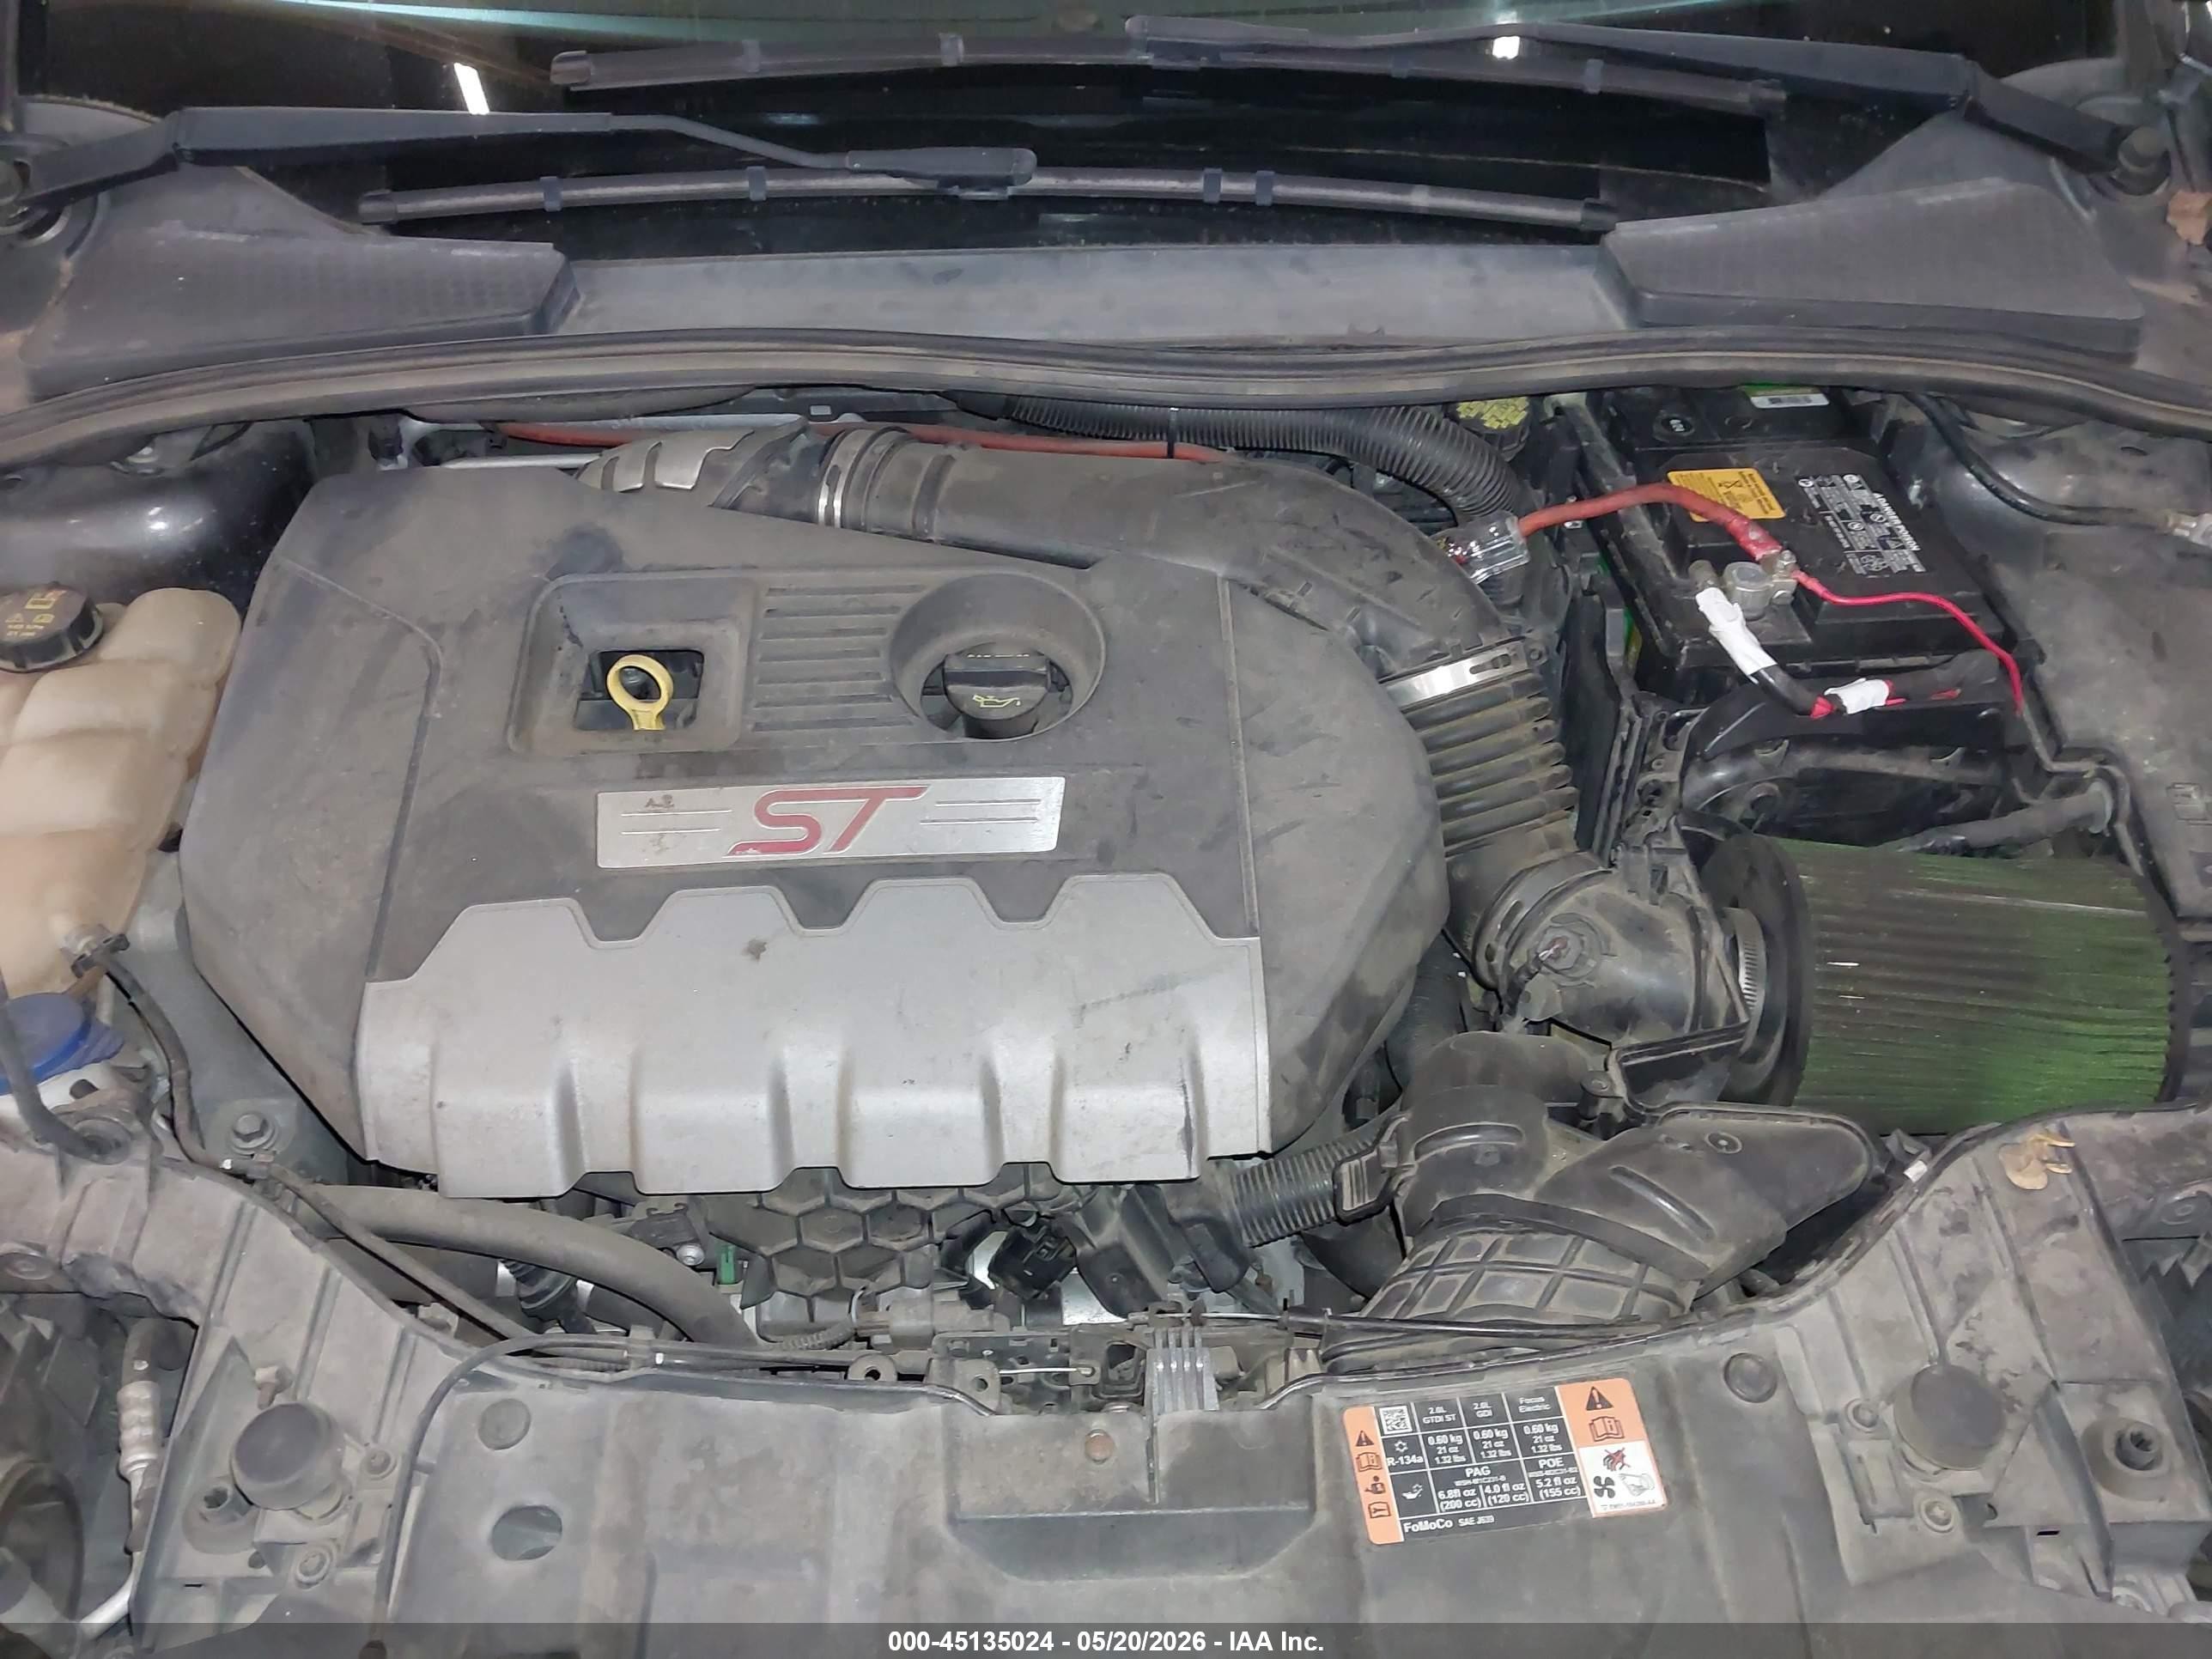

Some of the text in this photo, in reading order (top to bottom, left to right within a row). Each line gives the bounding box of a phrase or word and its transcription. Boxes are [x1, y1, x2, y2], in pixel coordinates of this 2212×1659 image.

[725, 784, 930, 858] ST
[1445, 1413, 1457, 1423] ST
[1473, 1428, 1509, 1441] 0.60 kg
[1523, 1423, 1559, 1435] 0.60 kg
[1427, 1433, 1463, 1446] 0.60 kg
[1387, 1455, 1424, 1467] R-134a
[1539, 1457, 1565, 1468] POE
[1465, 1466, 1491, 1478] PAG
[1535, 1479, 1553, 1488] 5.2
[1563, 1476, 1577, 1485] oz
[1485, 1485, 1500, 1494] 4.0
[1512, 1483, 1526, 1492] oz
[1539, 1486, 1581, 1500] (155 cc)
[1440, 1498, 1482, 1512] (200 cc)
[1487, 1492, 1529, 1507] (120 cc)
[1402, 1518, 1454, 1533] FoMoCo
[1458, 1516, 1476, 1527] SAE
